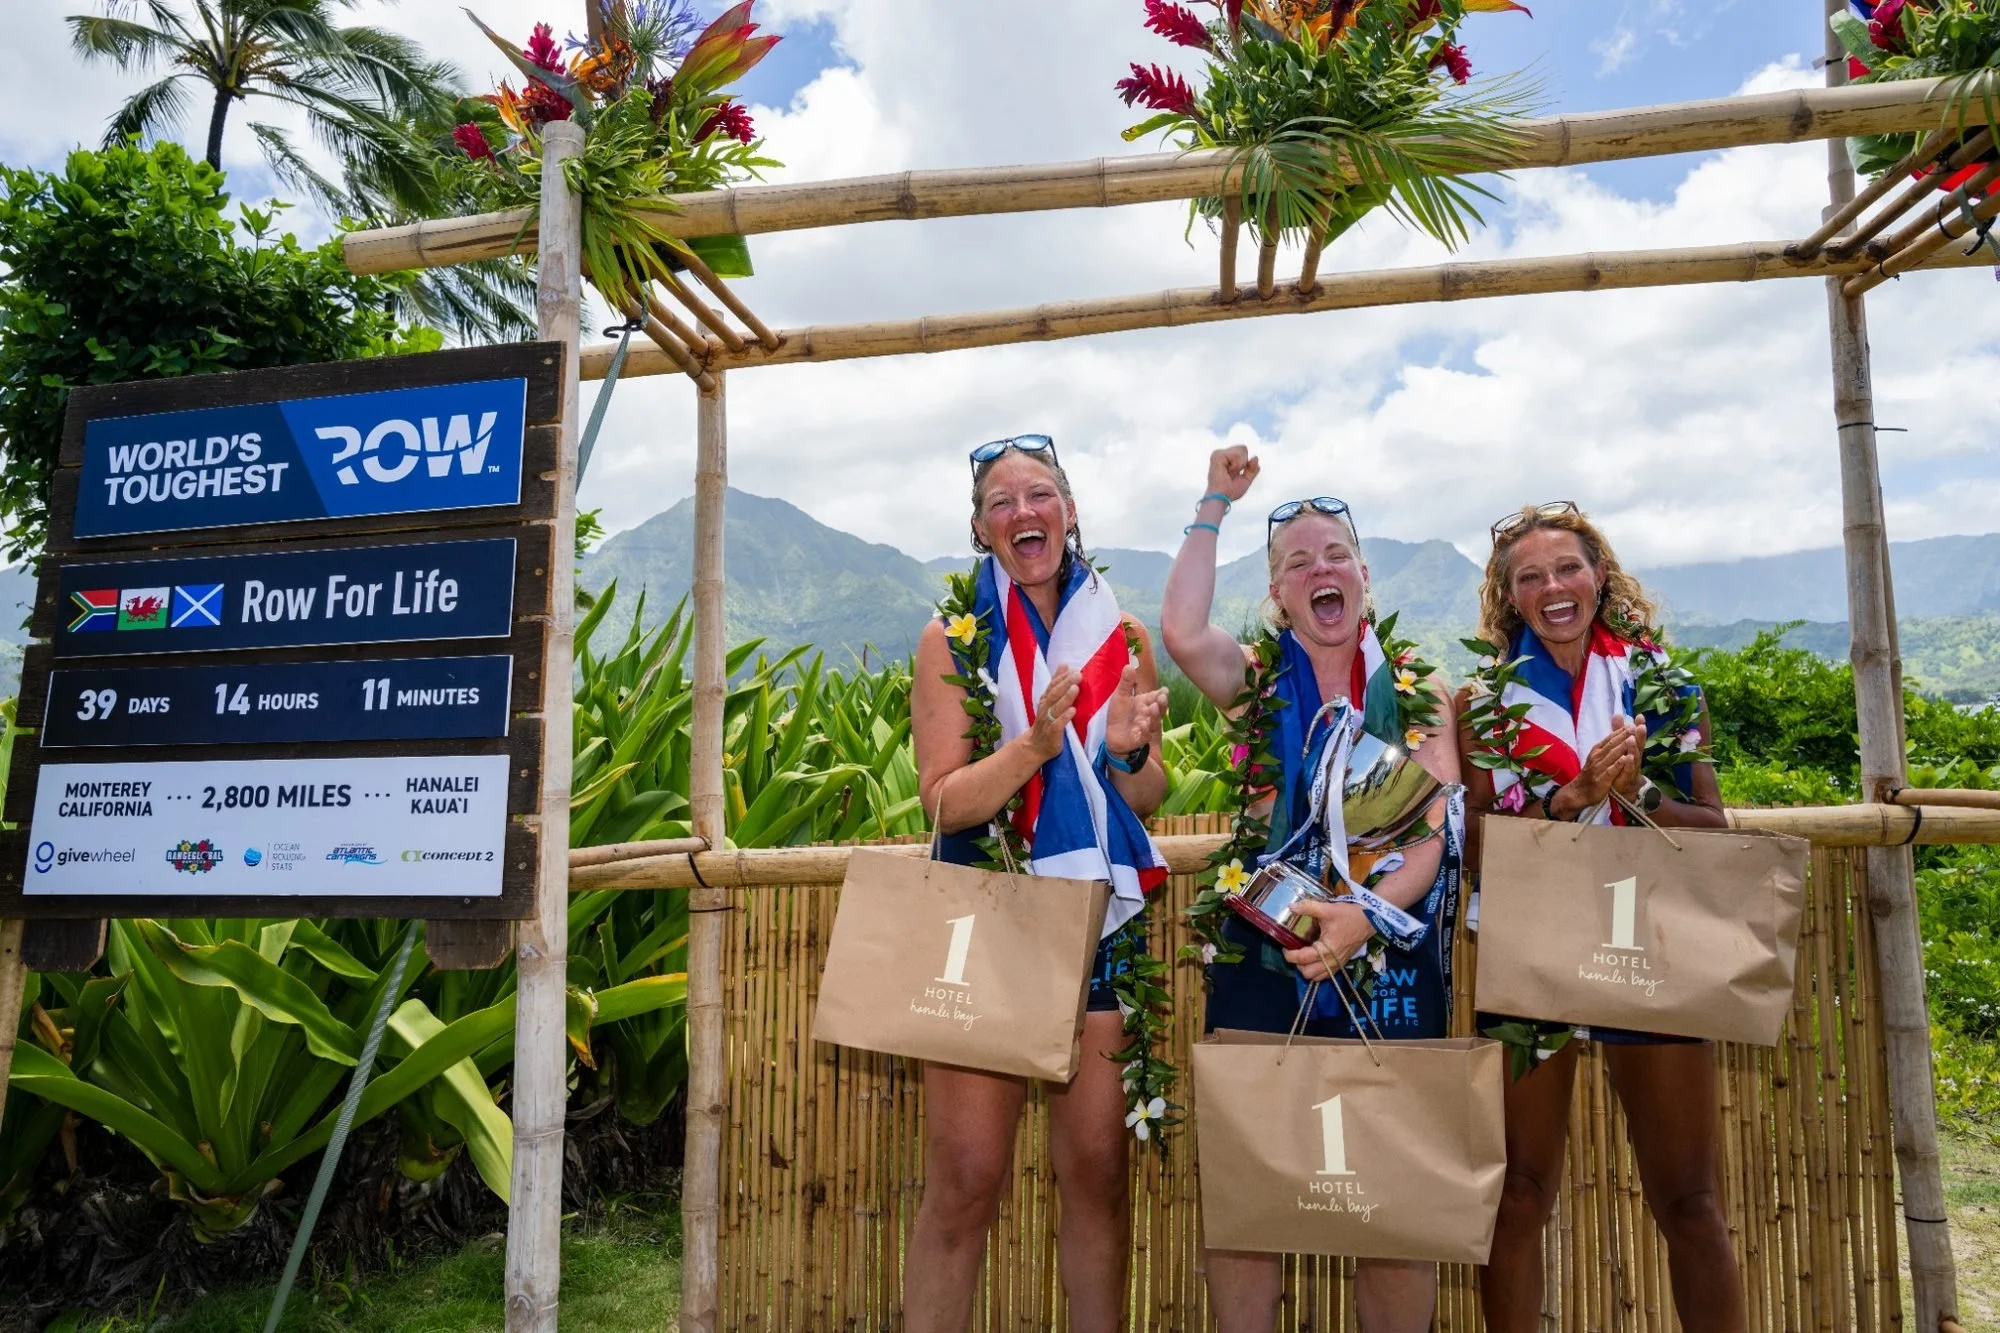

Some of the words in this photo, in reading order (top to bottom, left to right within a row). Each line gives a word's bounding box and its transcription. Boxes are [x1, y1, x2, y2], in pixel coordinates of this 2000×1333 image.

[107, 433, 261, 474] WORLD'S
[314, 411, 498, 485] ROW
[104, 462, 290, 506] TOUGHEST
[241, 579, 317, 623] Row
[326, 574, 383, 620] For
[392, 568, 459, 615] Life
[76, 688, 117, 722] 39
[128, 696, 170, 714] DAYS
[213, 682, 251, 716] 14
[258, 692, 319, 711] HOURS
[361, 678, 391, 711] 11
[397, 686, 480, 707] MINUTES
[64, 781, 152, 799] MONTEREY
[201, 784, 271, 813] 2,800
[277, 783, 353, 809] MILES
[406, 776, 479, 793] HANALEI
[58, 800, 154, 818] CALIFORNIA
[57, 847, 136, 866] givewheel
[273, 843, 300, 852] OCEAN
[421, 851, 482, 861] concept
[484, 851, 494, 862] 2
[271, 862, 293, 871] STATS
[1446, 894, 1456, 917] ROW
[1601, 875, 1645, 952] 1
[934, 913, 976, 987] 1
[1592, 951, 1652, 971] HOTEL
[1371, 988, 1398, 998] FOR
[1578, 965, 1627, 986] hanalei
[1630, 970, 1666, 997] bay
[924, 986, 973, 1005] HOTEL
[910, 998, 951, 1022] hanalei
[953, 1006, 983, 1031] bay
[1350, 997, 1418, 1024] LIFE
[1311, 1094, 1357, 1176] 1
[1308, 1181, 1366, 1196] HOTEL
[1297, 1196, 1345, 1214] hanalei
[1346, 1198, 1380, 1224] bay
